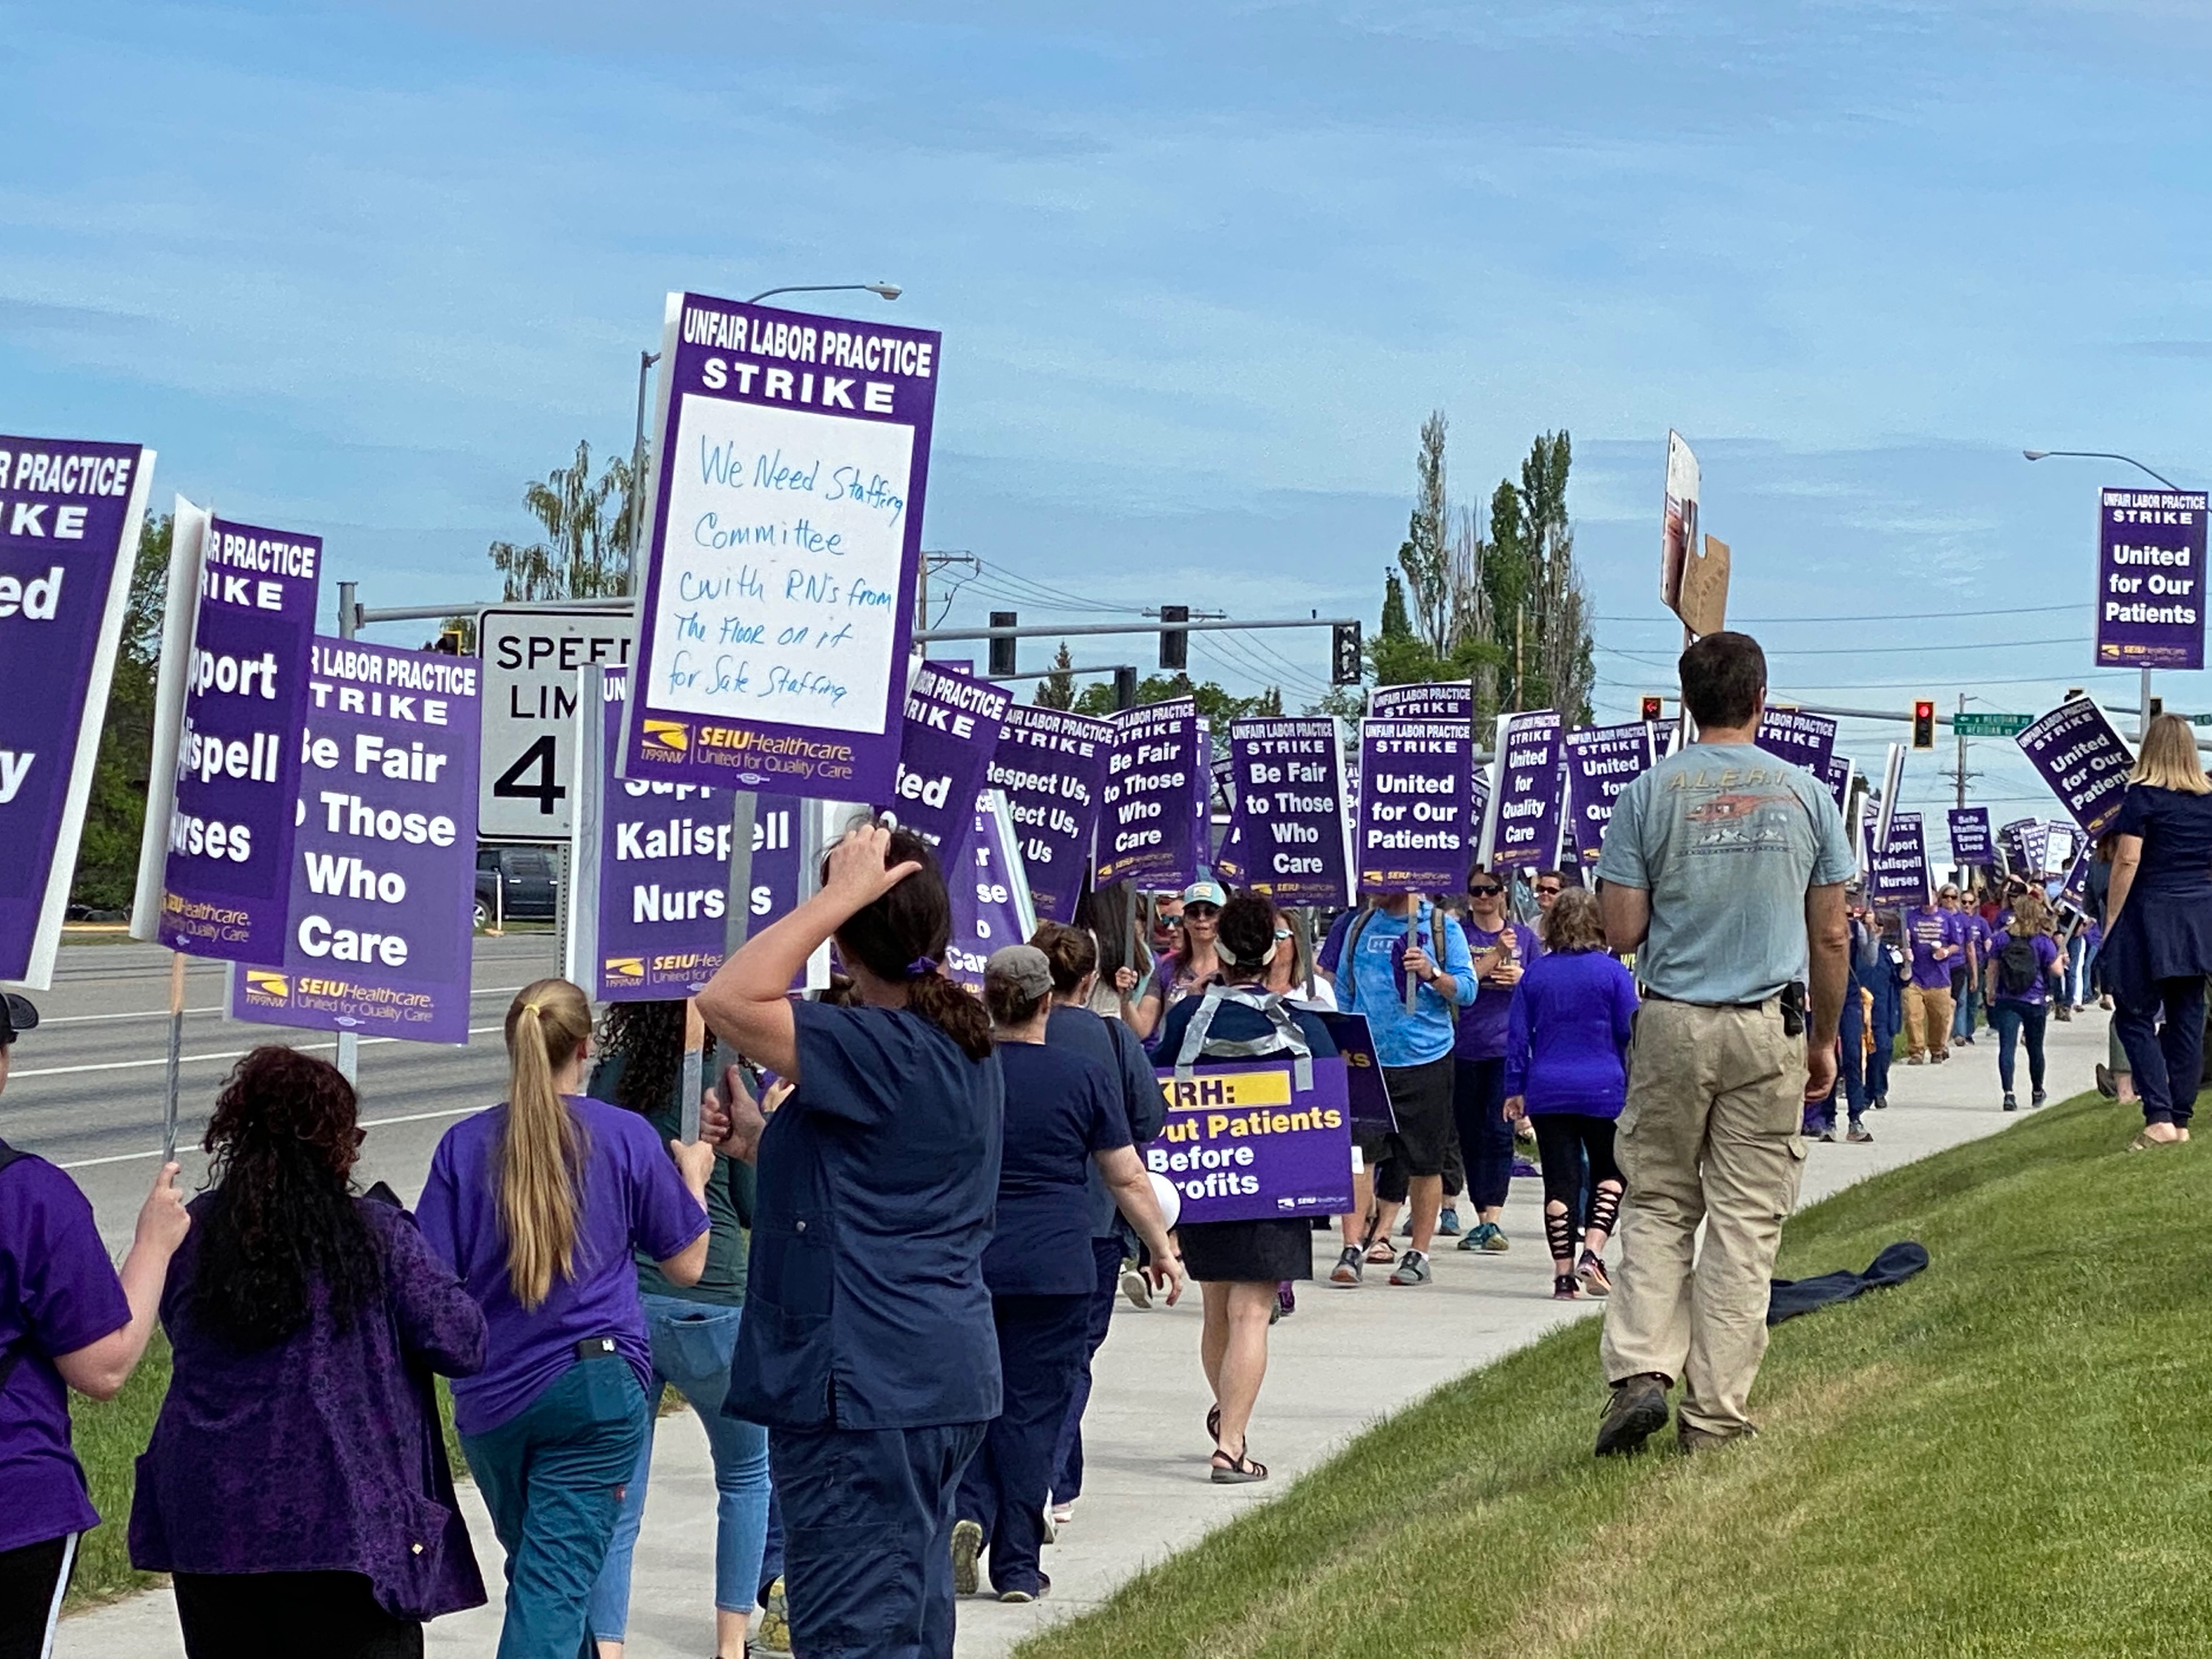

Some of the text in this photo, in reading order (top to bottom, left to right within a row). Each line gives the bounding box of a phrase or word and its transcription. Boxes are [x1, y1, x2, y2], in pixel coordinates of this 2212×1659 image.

[683, 307, 933, 378] UNFAIR LABOR PRACTICE
[701, 357, 895, 414] STRIKE
[14, 453, 131, 497] PRACTICE
[701, 434, 904, 527] We Need Staffing
[2133, 495, 2160, 508] LABOR
[2162, 495, 2205, 510] PRACTICE
[2113, 510, 2192, 525] STRIKE
[695, 512, 845, 556] Committee
[223, 533, 316, 579] PRACTICE
[2113, 544, 2190, 567] United
[847, 577, 892, 614] from
[2109, 573, 2194, 595] for Our
[2106, 601, 2196, 624] Patients
[674, 611, 705, 642] The
[777, 627, 809, 646] on
[188, 647, 277, 699] pport
[323, 648, 382, 684] LABOR
[386, 657, 476, 696] PRACTICE
[669, 650, 701, 695] for
[309, 683, 447, 725] TRIKE
[511, 685, 578, 718] LIM
[933, 676, 1007, 722] PRACTICE
[1401, 689, 1427, 702] LABOR
[1430, 687, 1471, 701] PRACTICE
[904, 697, 975, 739] RIKE
[1125, 703, 1195, 727] LABOR PRACTICE
[1383, 702, 1458, 718] STRIKE
[1004, 709, 1114, 744] AIR LABOR PRACTICE
[1232, 722, 1333, 739] UNFAIR LABOR PRACTICE
[1396, 725, 1425, 738] LABOR
[1427, 724, 1470, 739] PRACTICE
[1510, 730, 1551, 745] STRIKE
[1758, 726, 1820, 748] TRIKE
[1763, 712, 1834, 737] LABOR PRACTICE
[2034, 712, 2093, 750] STRIKE
[998, 726, 1095, 758] STRIKE
[1246, 741, 1325, 754] STRIKE
[1376, 741, 1457, 753] STRIKE
[1577, 739, 1640, 756] STRIKE
[2050, 733, 2110, 773] United
[355, 733, 447, 783] Fair
[697, 749, 741, 767] United
[744, 754, 760, 771] for
[765, 756, 815, 780] Quality
[817, 761, 853, 780] Care
[1109, 742, 1181, 774] Be Fair
[1509, 747, 1547, 769] United
[1582, 756, 1639, 777] United
[494, 735, 566, 815] 4
[1250, 762, 1327, 783] Be Fair
[1376, 775, 1455, 794] United
[1515, 775, 1534, 792] for
[2062, 752, 2123, 792] for Our
[895, 763, 952, 809] ted
[1061, 775, 1090, 806] Us,
[1103, 773, 1185, 804] to Those
[2071, 769, 2131, 811] Patient
[1118, 801, 1162, 825] Who
[1246, 793, 1334, 814] to Those
[1372, 802, 1458, 821] for Our
[1502, 799, 1545, 819] Quality
[321, 792, 456, 860] Those
[1010, 800, 1079, 839] tect Us,
[1958, 815, 1979, 824] Safe
[1115, 829, 1162, 853] Care
[1271, 823, 1319, 843] Who
[1368, 830, 1460, 849] Patients
[1505, 825, 1534, 843] Care
[1888, 838, 1919, 854] pport
[1957, 834, 1984, 843] Saves
[1027, 838, 1052, 863] Us
[1273, 853, 1324, 874] Care
[1872, 856, 1922, 871] Kalispell
[304, 852, 406, 903] Who
[1879, 876, 1919, 888] Nurses
[633, 885, 771, 923] Nurss
[222, 926, 249, 943] Care
[298, 915, 408, 966] Care
[945, 945, 987, 973] Car
[298, 994, 337, 1012] United
[359, 1002, 401, 1023] Quality
[404, 1007, 433, 1022] Care
[1160, 1107, 1342, 1143] ut Patients
[1147, 1147, 1254, 1173] Before
[1178, 1172, 1259, 1200] rofits
